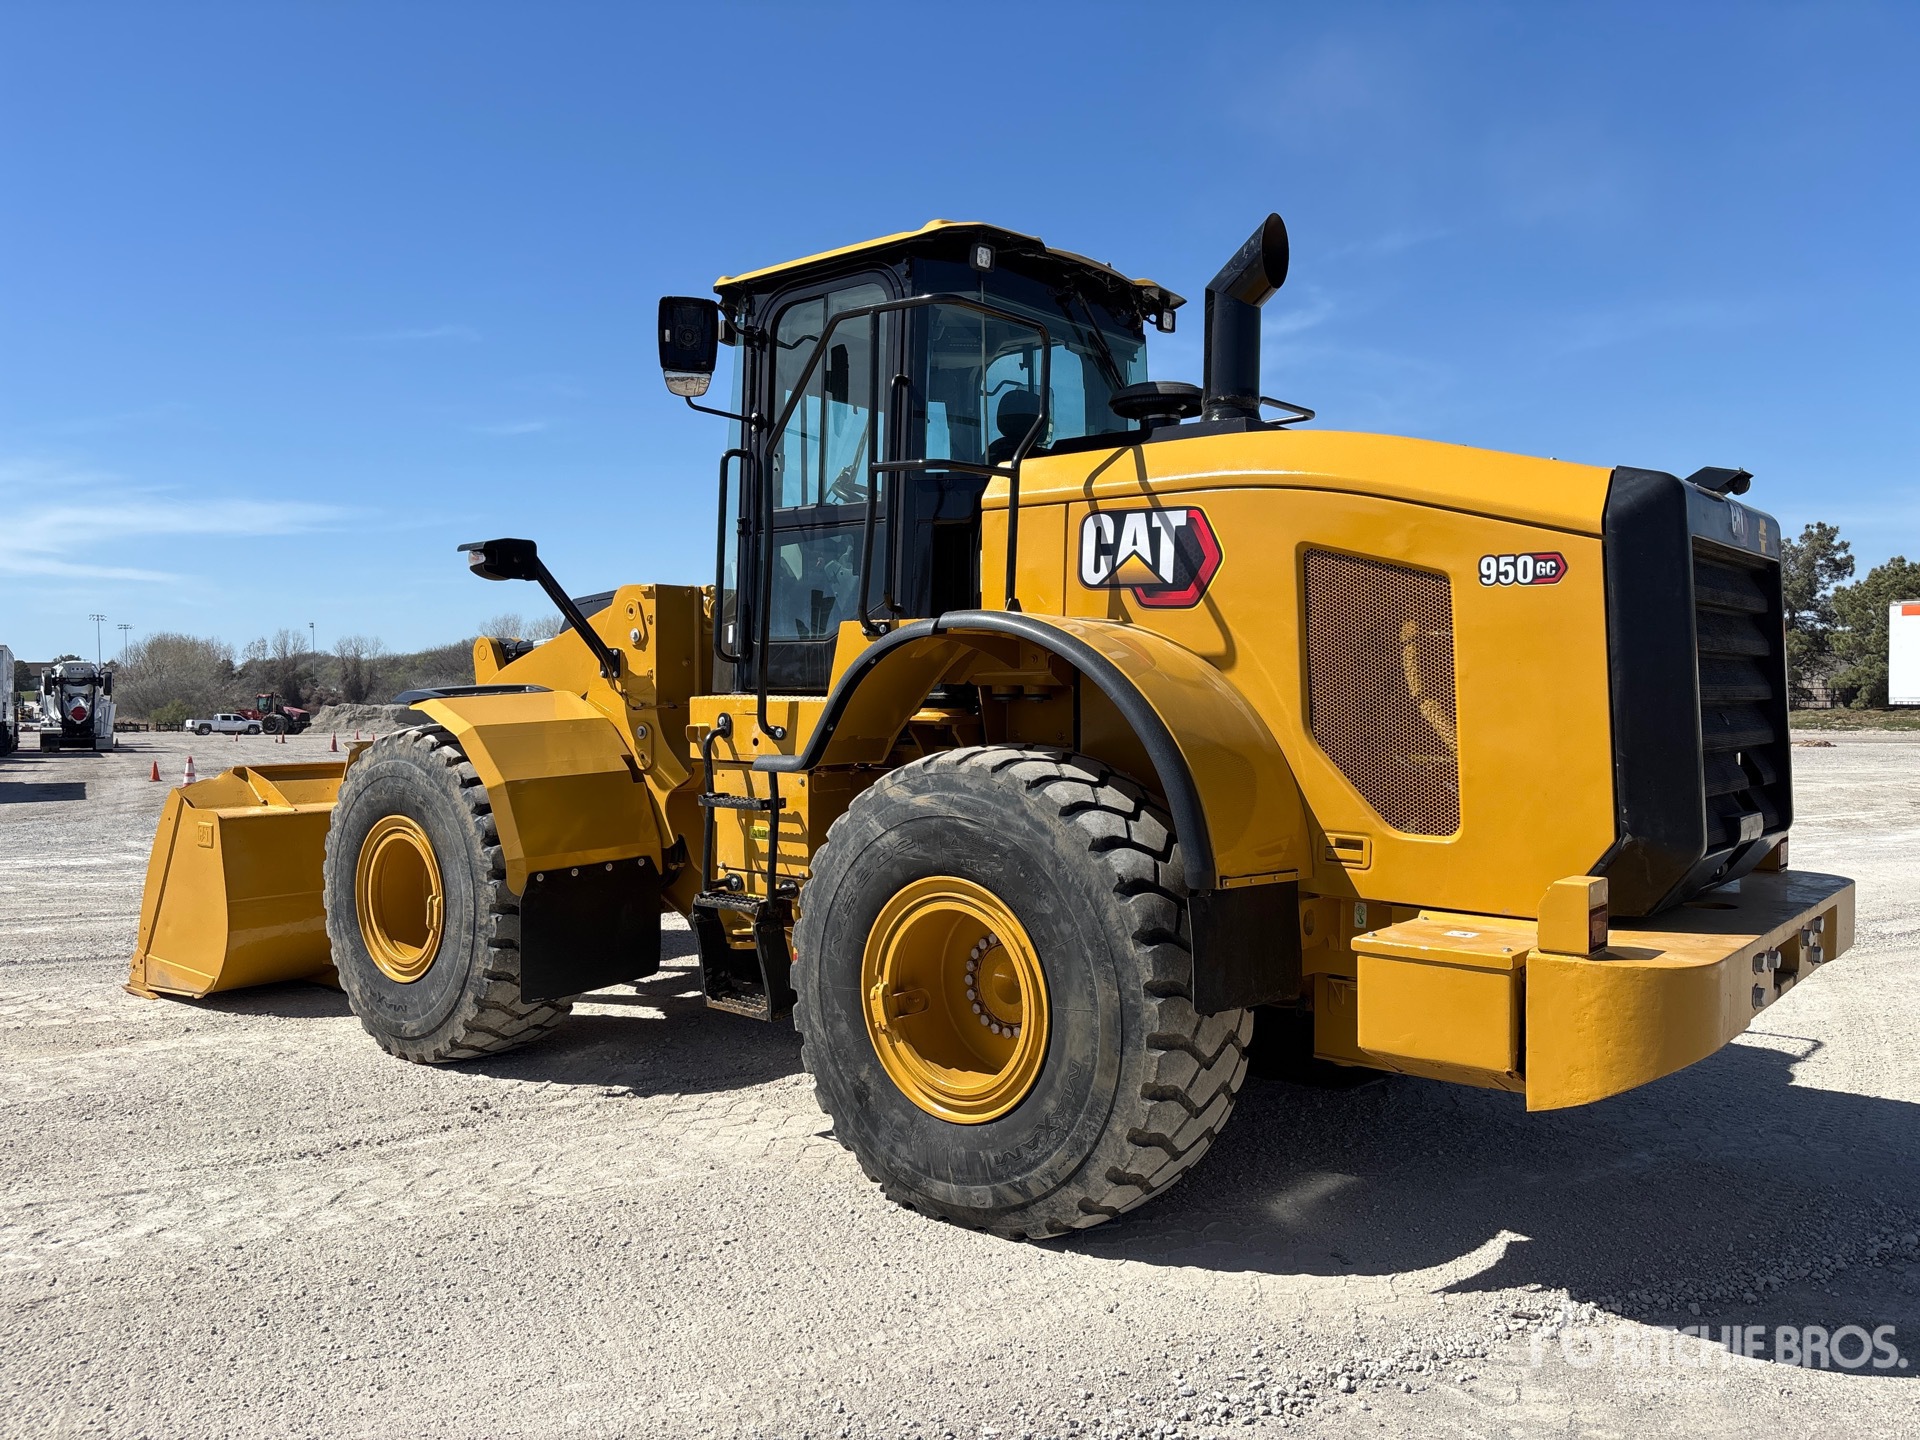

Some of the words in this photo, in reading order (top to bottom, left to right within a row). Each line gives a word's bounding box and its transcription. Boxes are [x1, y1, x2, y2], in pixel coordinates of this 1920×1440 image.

[1082, 510, 1187, 585] CAT
[1480, 555, 1534, 584] 950
[1536, 561, 1556, 577] GC
[993, 1060, 1081, 1168] MAXAM
